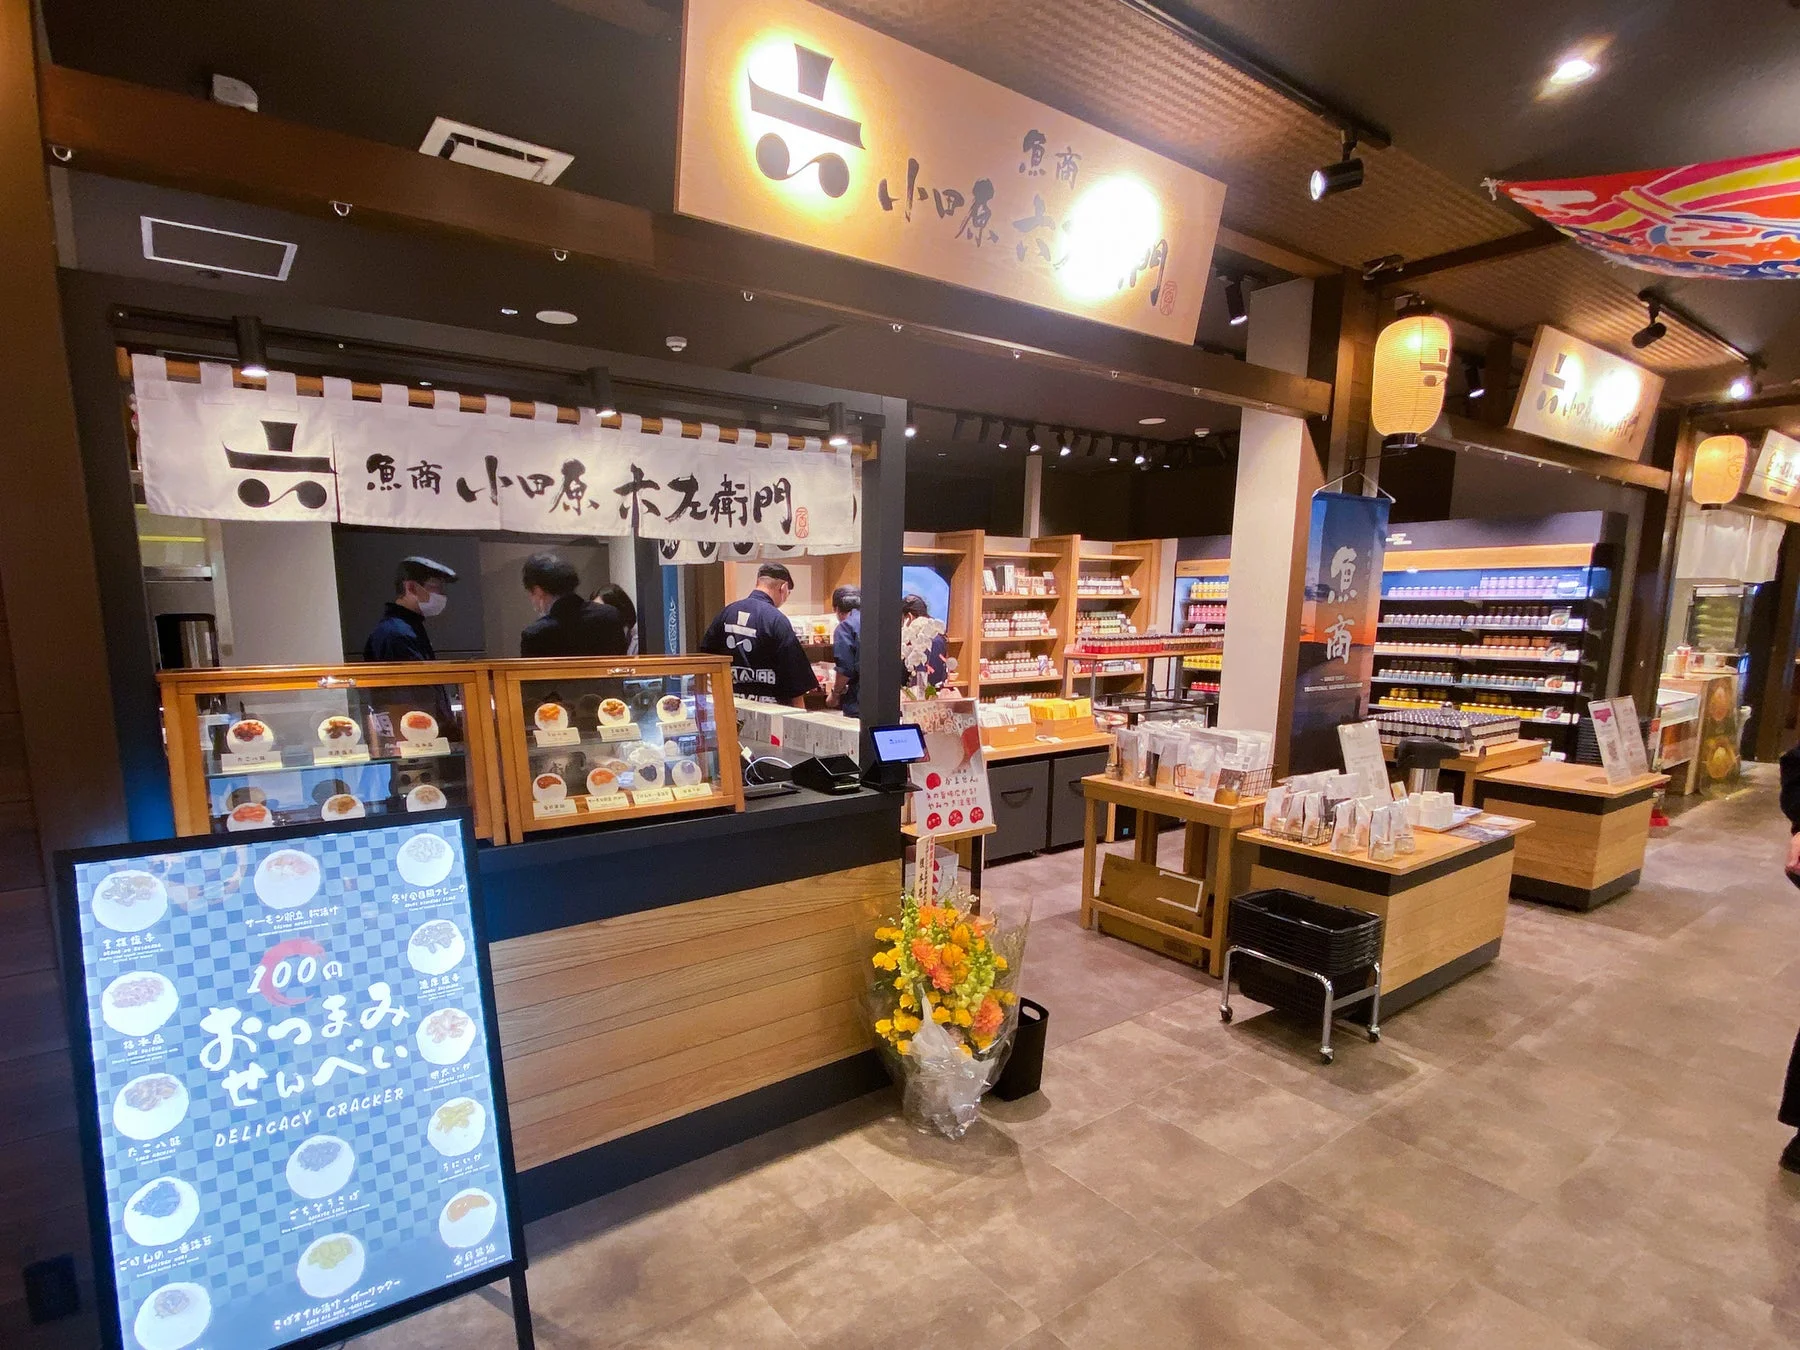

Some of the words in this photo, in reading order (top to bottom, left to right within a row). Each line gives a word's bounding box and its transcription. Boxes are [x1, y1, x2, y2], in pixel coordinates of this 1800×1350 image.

[1018, 129, 1082, 190] 魚商
[366, 453, 442, 495] 魚商
[456, 455, 600, 516] 小田原
[613, 462, 793, 535] 六左衛門
[1323, 546, 1358, 665] 魚商
[199, 981, 411, 1072] おつまみ
[220, 1038, 409, 1107] せんべい
[214, 1109, 313, 1148] DELICACY
[326, 1087, 405, 1119] CRACKER
